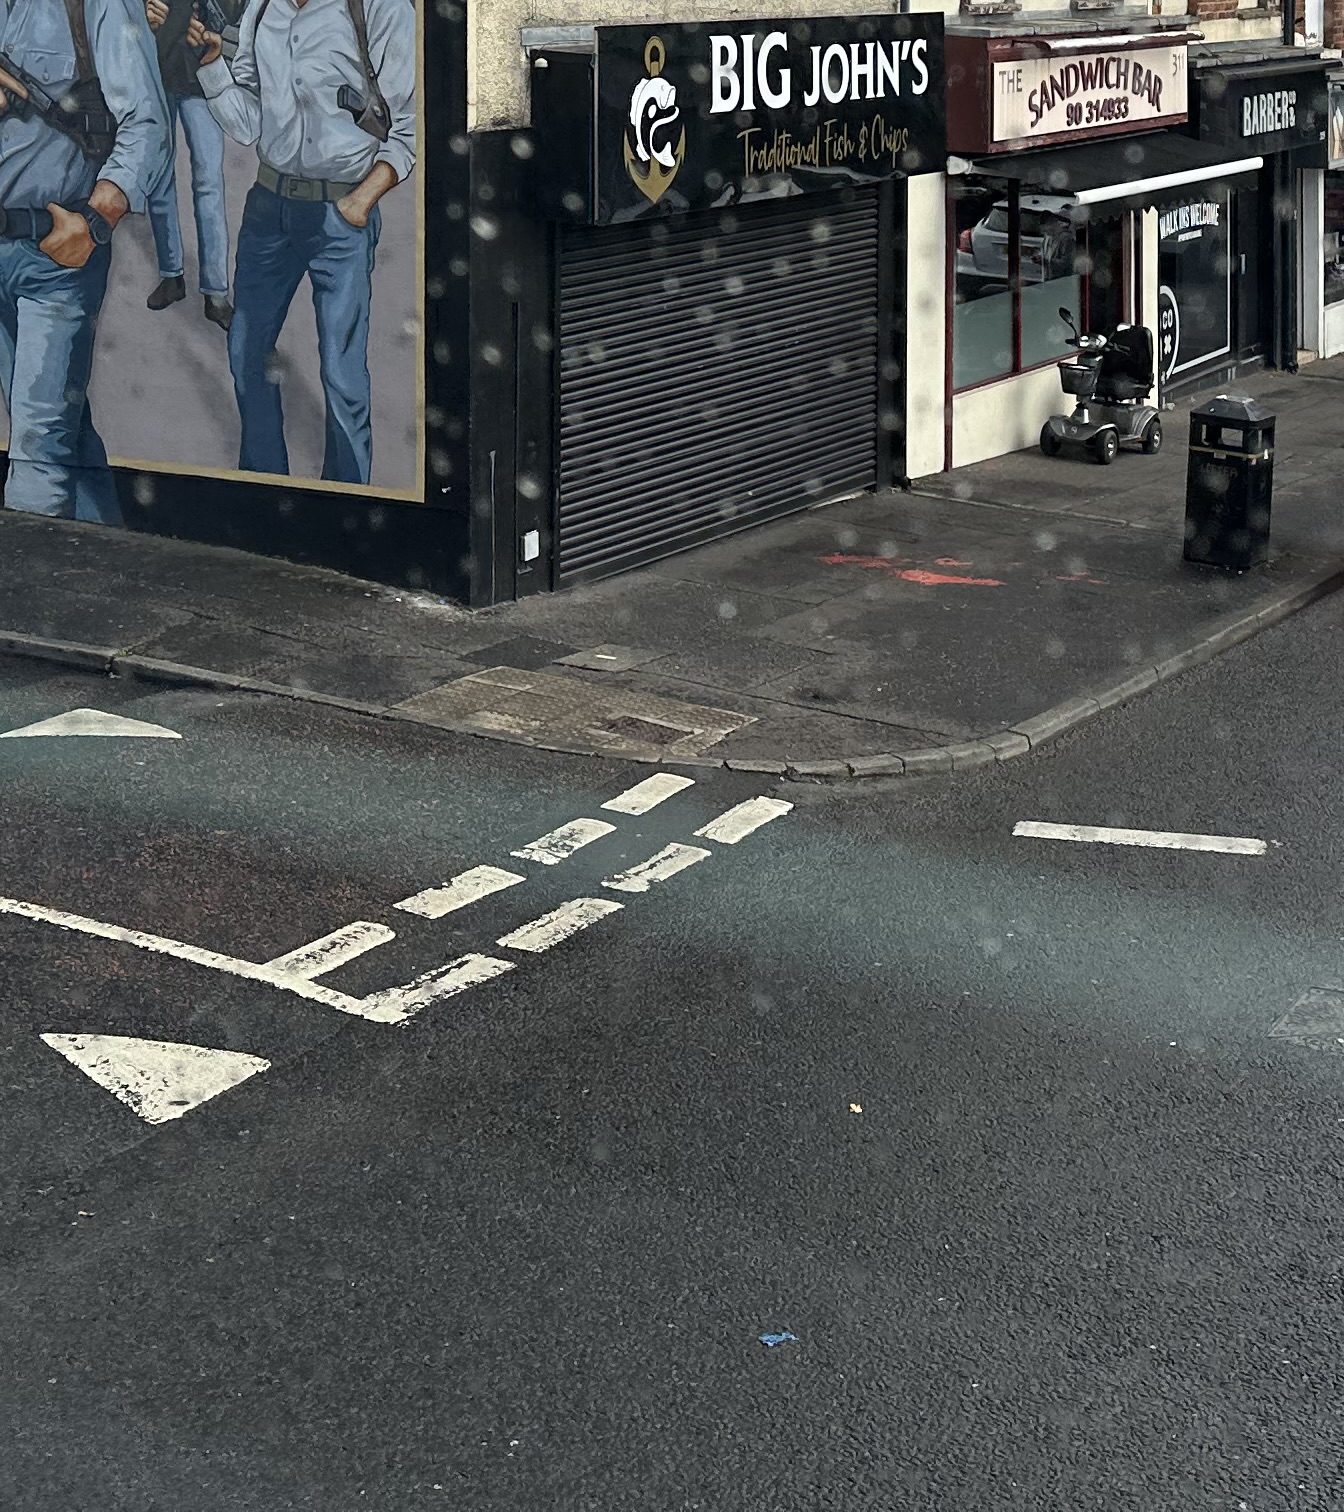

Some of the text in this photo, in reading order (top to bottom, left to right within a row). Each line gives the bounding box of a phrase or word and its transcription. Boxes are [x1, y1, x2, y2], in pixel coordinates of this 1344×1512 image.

[709, 31, 928, 113] BIG JOHN'S
[999, 69, 1022, 94] THE
[1172, 53, 1185, 76] 311
[1028, 57, 1163, 128] SANDWICH BAR
[1066, 96, 1129, 126] 90 314933
[1243, 90, 1289, 137] BARBER
[736, 114, 909, 178] Traditional Fish & Chips
[1190, 202, 1220, 227] WELCOME
